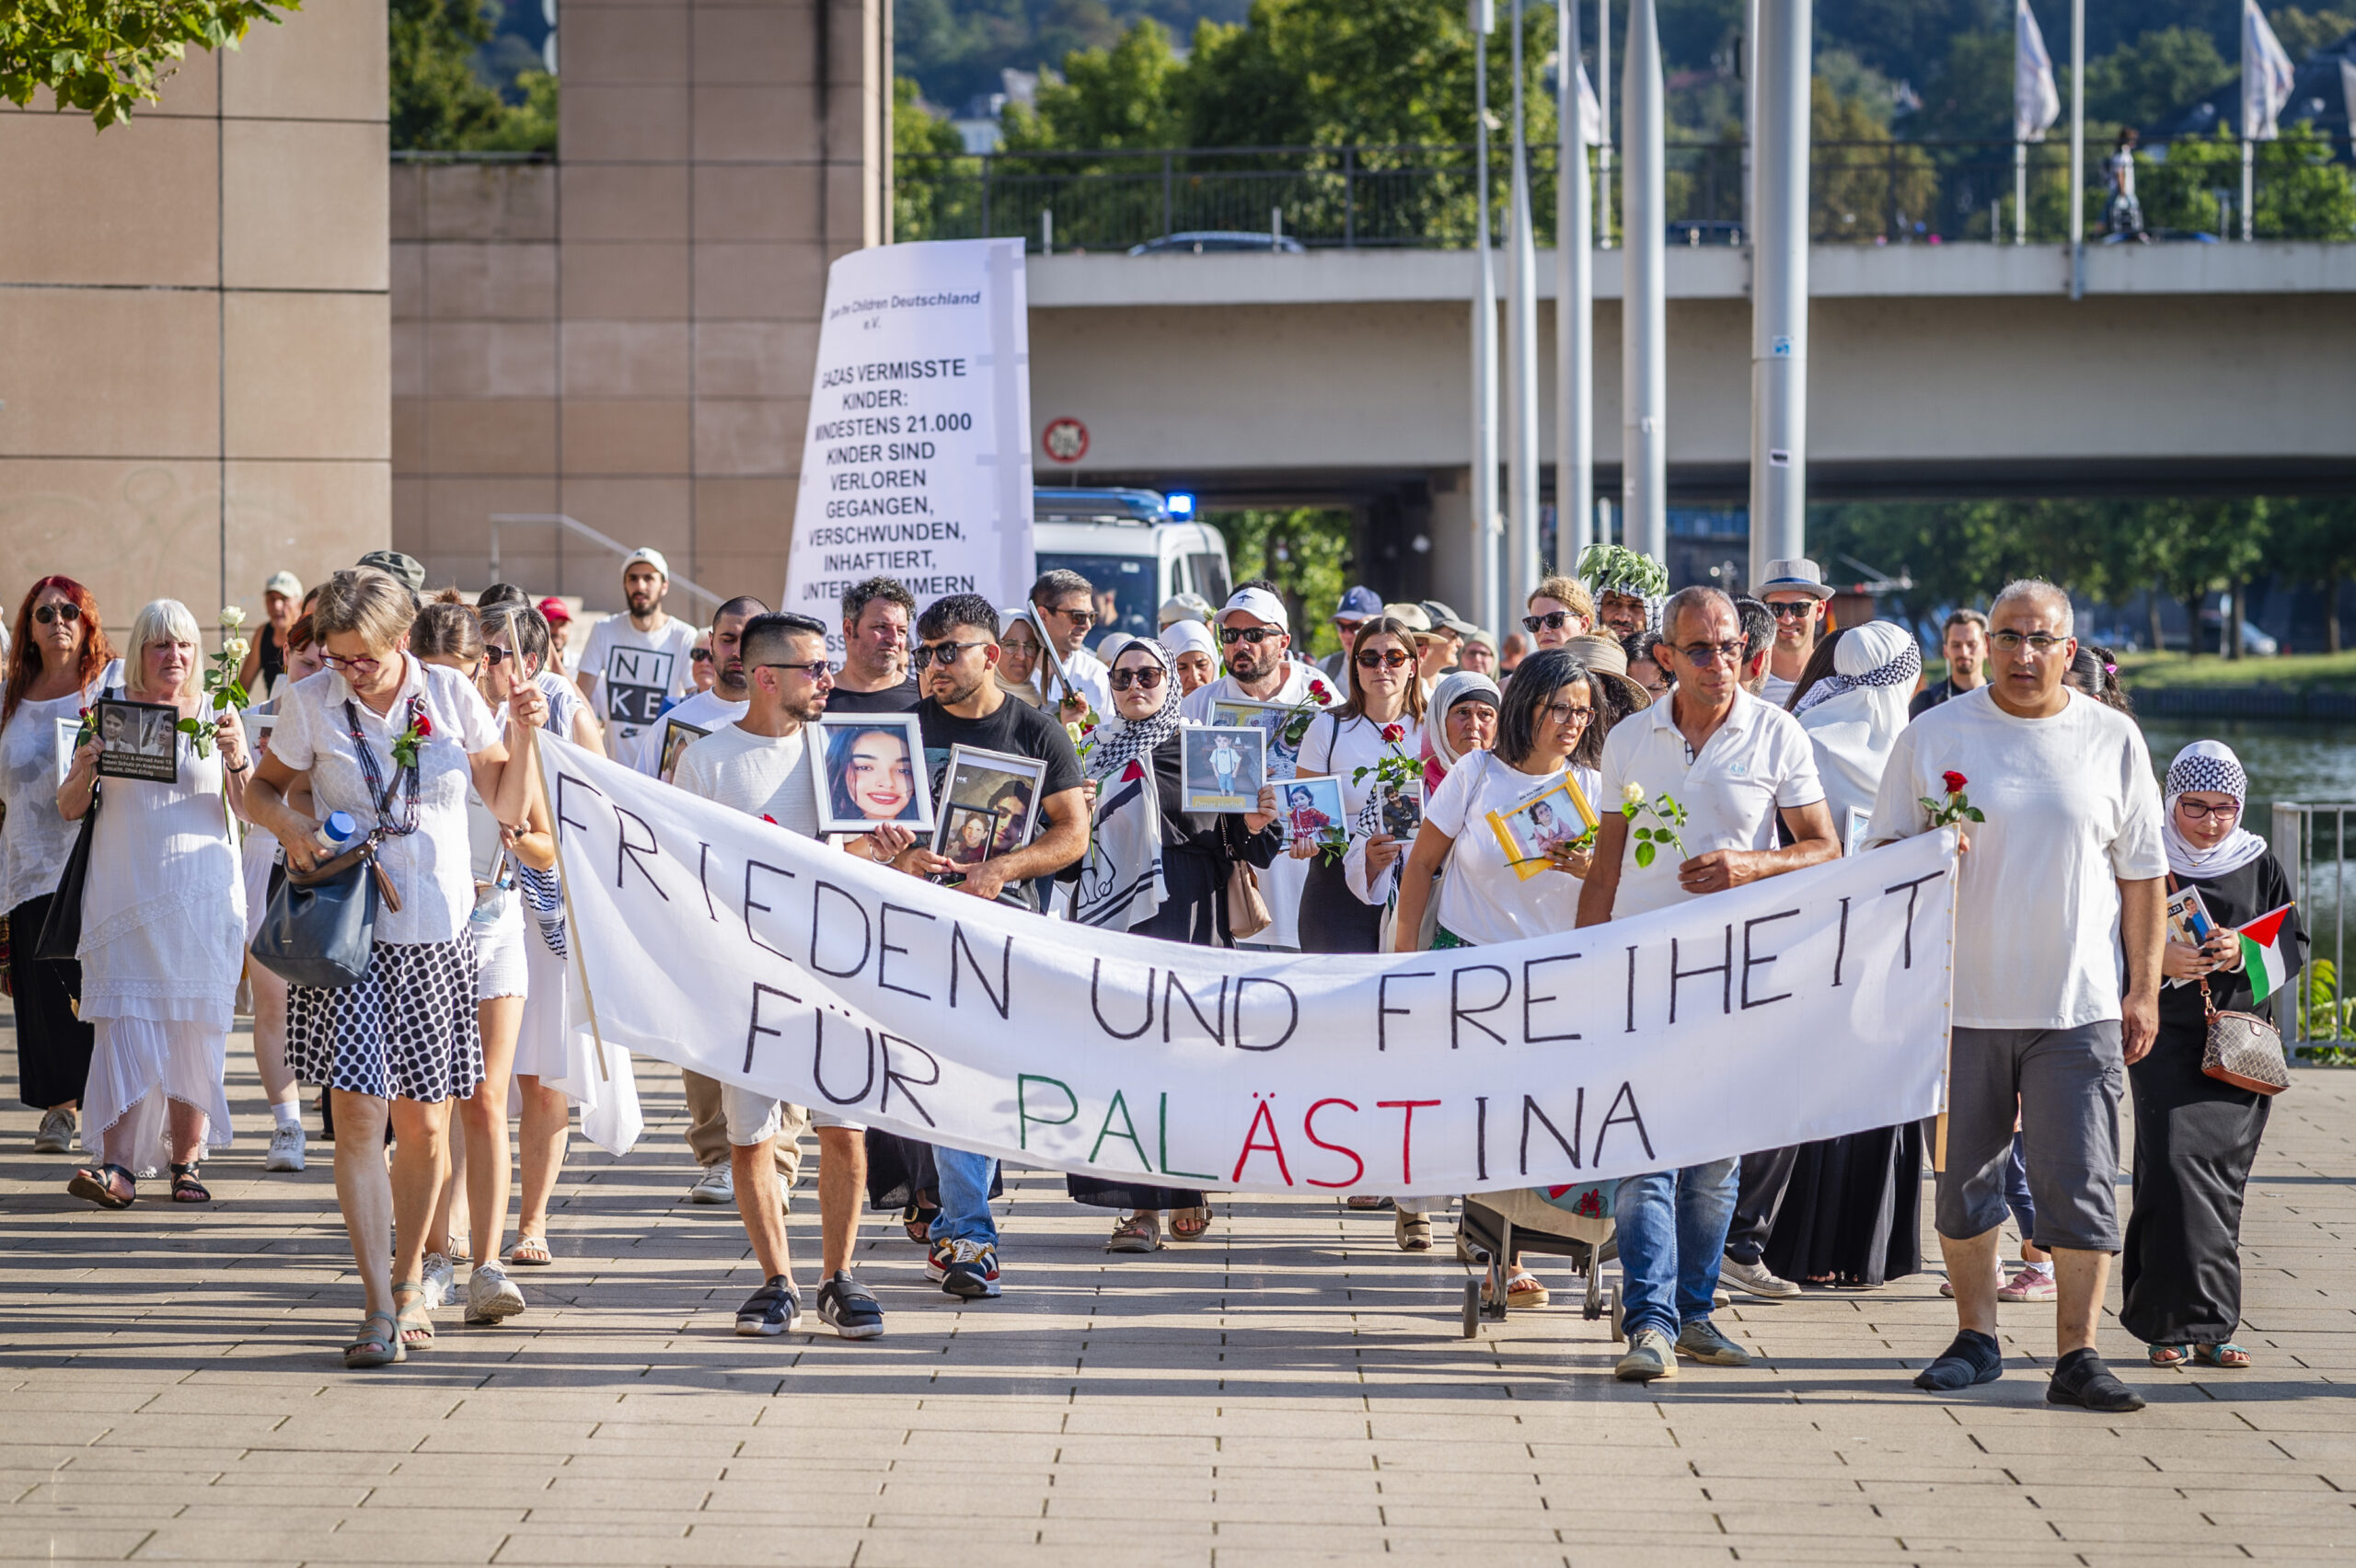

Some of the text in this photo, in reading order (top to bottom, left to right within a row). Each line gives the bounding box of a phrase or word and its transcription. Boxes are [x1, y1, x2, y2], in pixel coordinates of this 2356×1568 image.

[852, 297, 888, 314] Children
[891, 291, 982, 308] Deutschland
[858, 358, 966, 382] VERMISSTE
[842, 389, 908, 410] KINDER:
[907, 413, 972, 433] 21.000
[826, 442, 936, 467] KINDER SIND
[830, 469, 926, 491] VERLOREN
[826, 496, 934, 518] GEGANGEN,
[809, 522, 966, 547] VERSCHWUNDEN,
[825, 549, 937, 572] INHAFTIERT,
[557, 771, 1945, 1052] FRIEDEN UND FREIHEIT
[743, 981, 1656, 1188] FÜR PALÄSTINA
